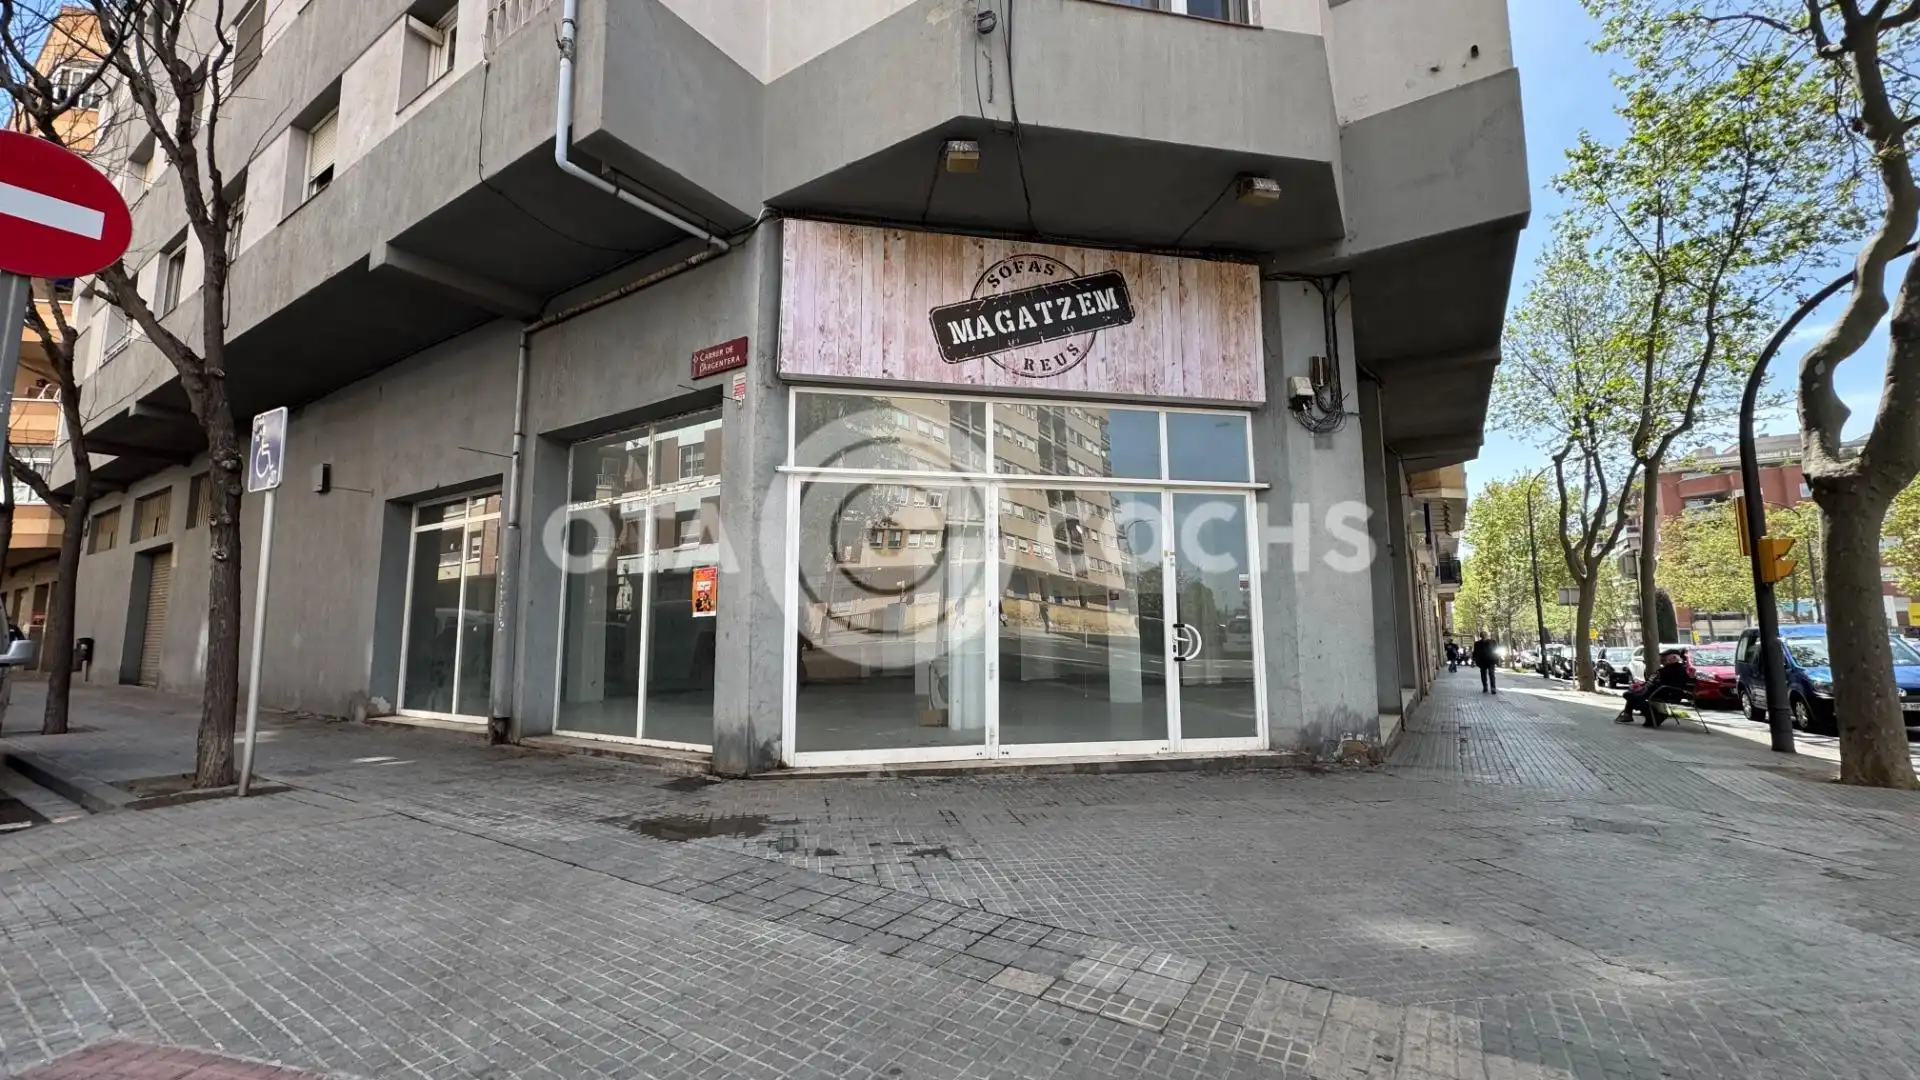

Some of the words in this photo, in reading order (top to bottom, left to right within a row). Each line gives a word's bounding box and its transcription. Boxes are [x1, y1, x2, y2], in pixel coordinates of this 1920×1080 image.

[986, 260, 1056, 288] SOFAS
[947, 287, 1120, 345] MAGATZEM
[699, 349, 724, 362] CARRER
[725, 345, 734, 354] DE
[1024, 343, 1081, 372] REUS
